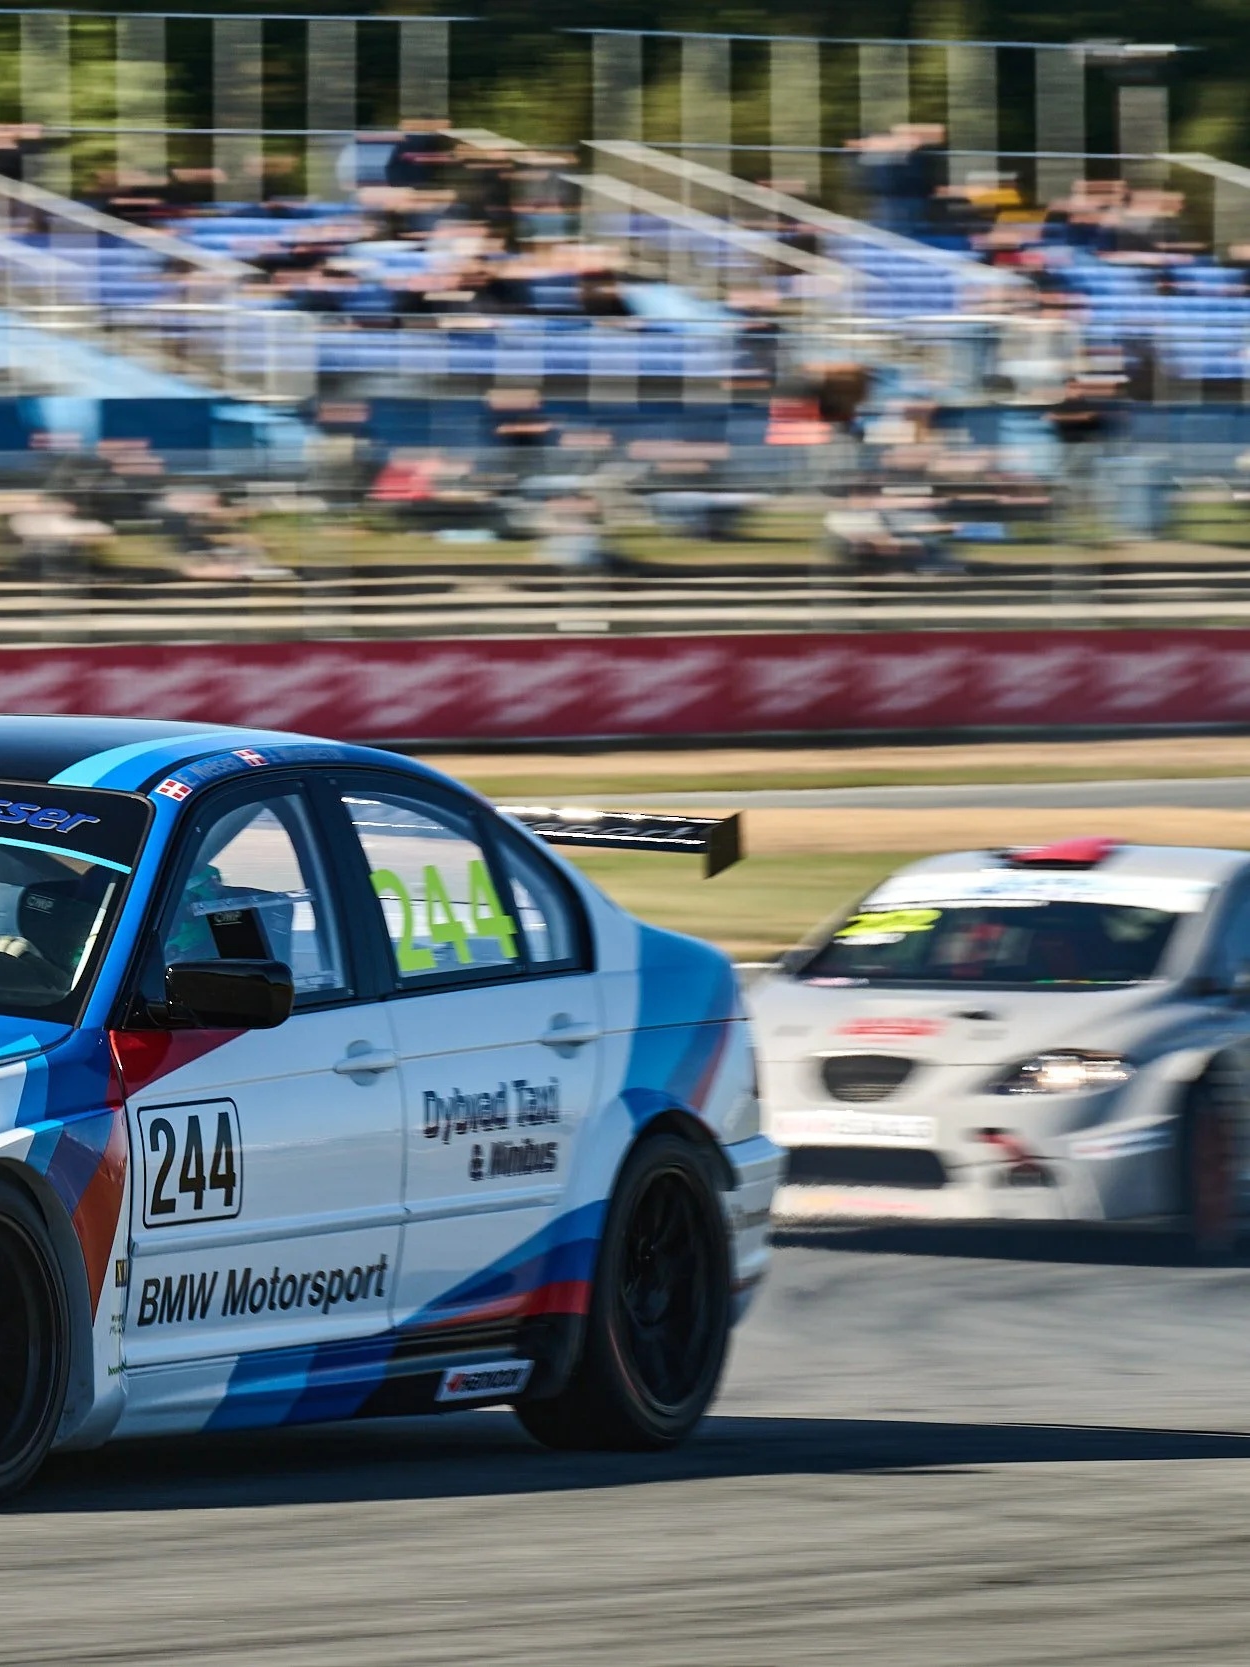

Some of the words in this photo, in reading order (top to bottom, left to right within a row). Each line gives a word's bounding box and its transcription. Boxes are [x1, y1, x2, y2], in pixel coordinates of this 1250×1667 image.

[368, 860, 518, 971] 244
[149, 1111, 236, 1216] 244
[137, 1271, 218, 1327] BMW
[221, 1253, 388, 1316] Motorsport
